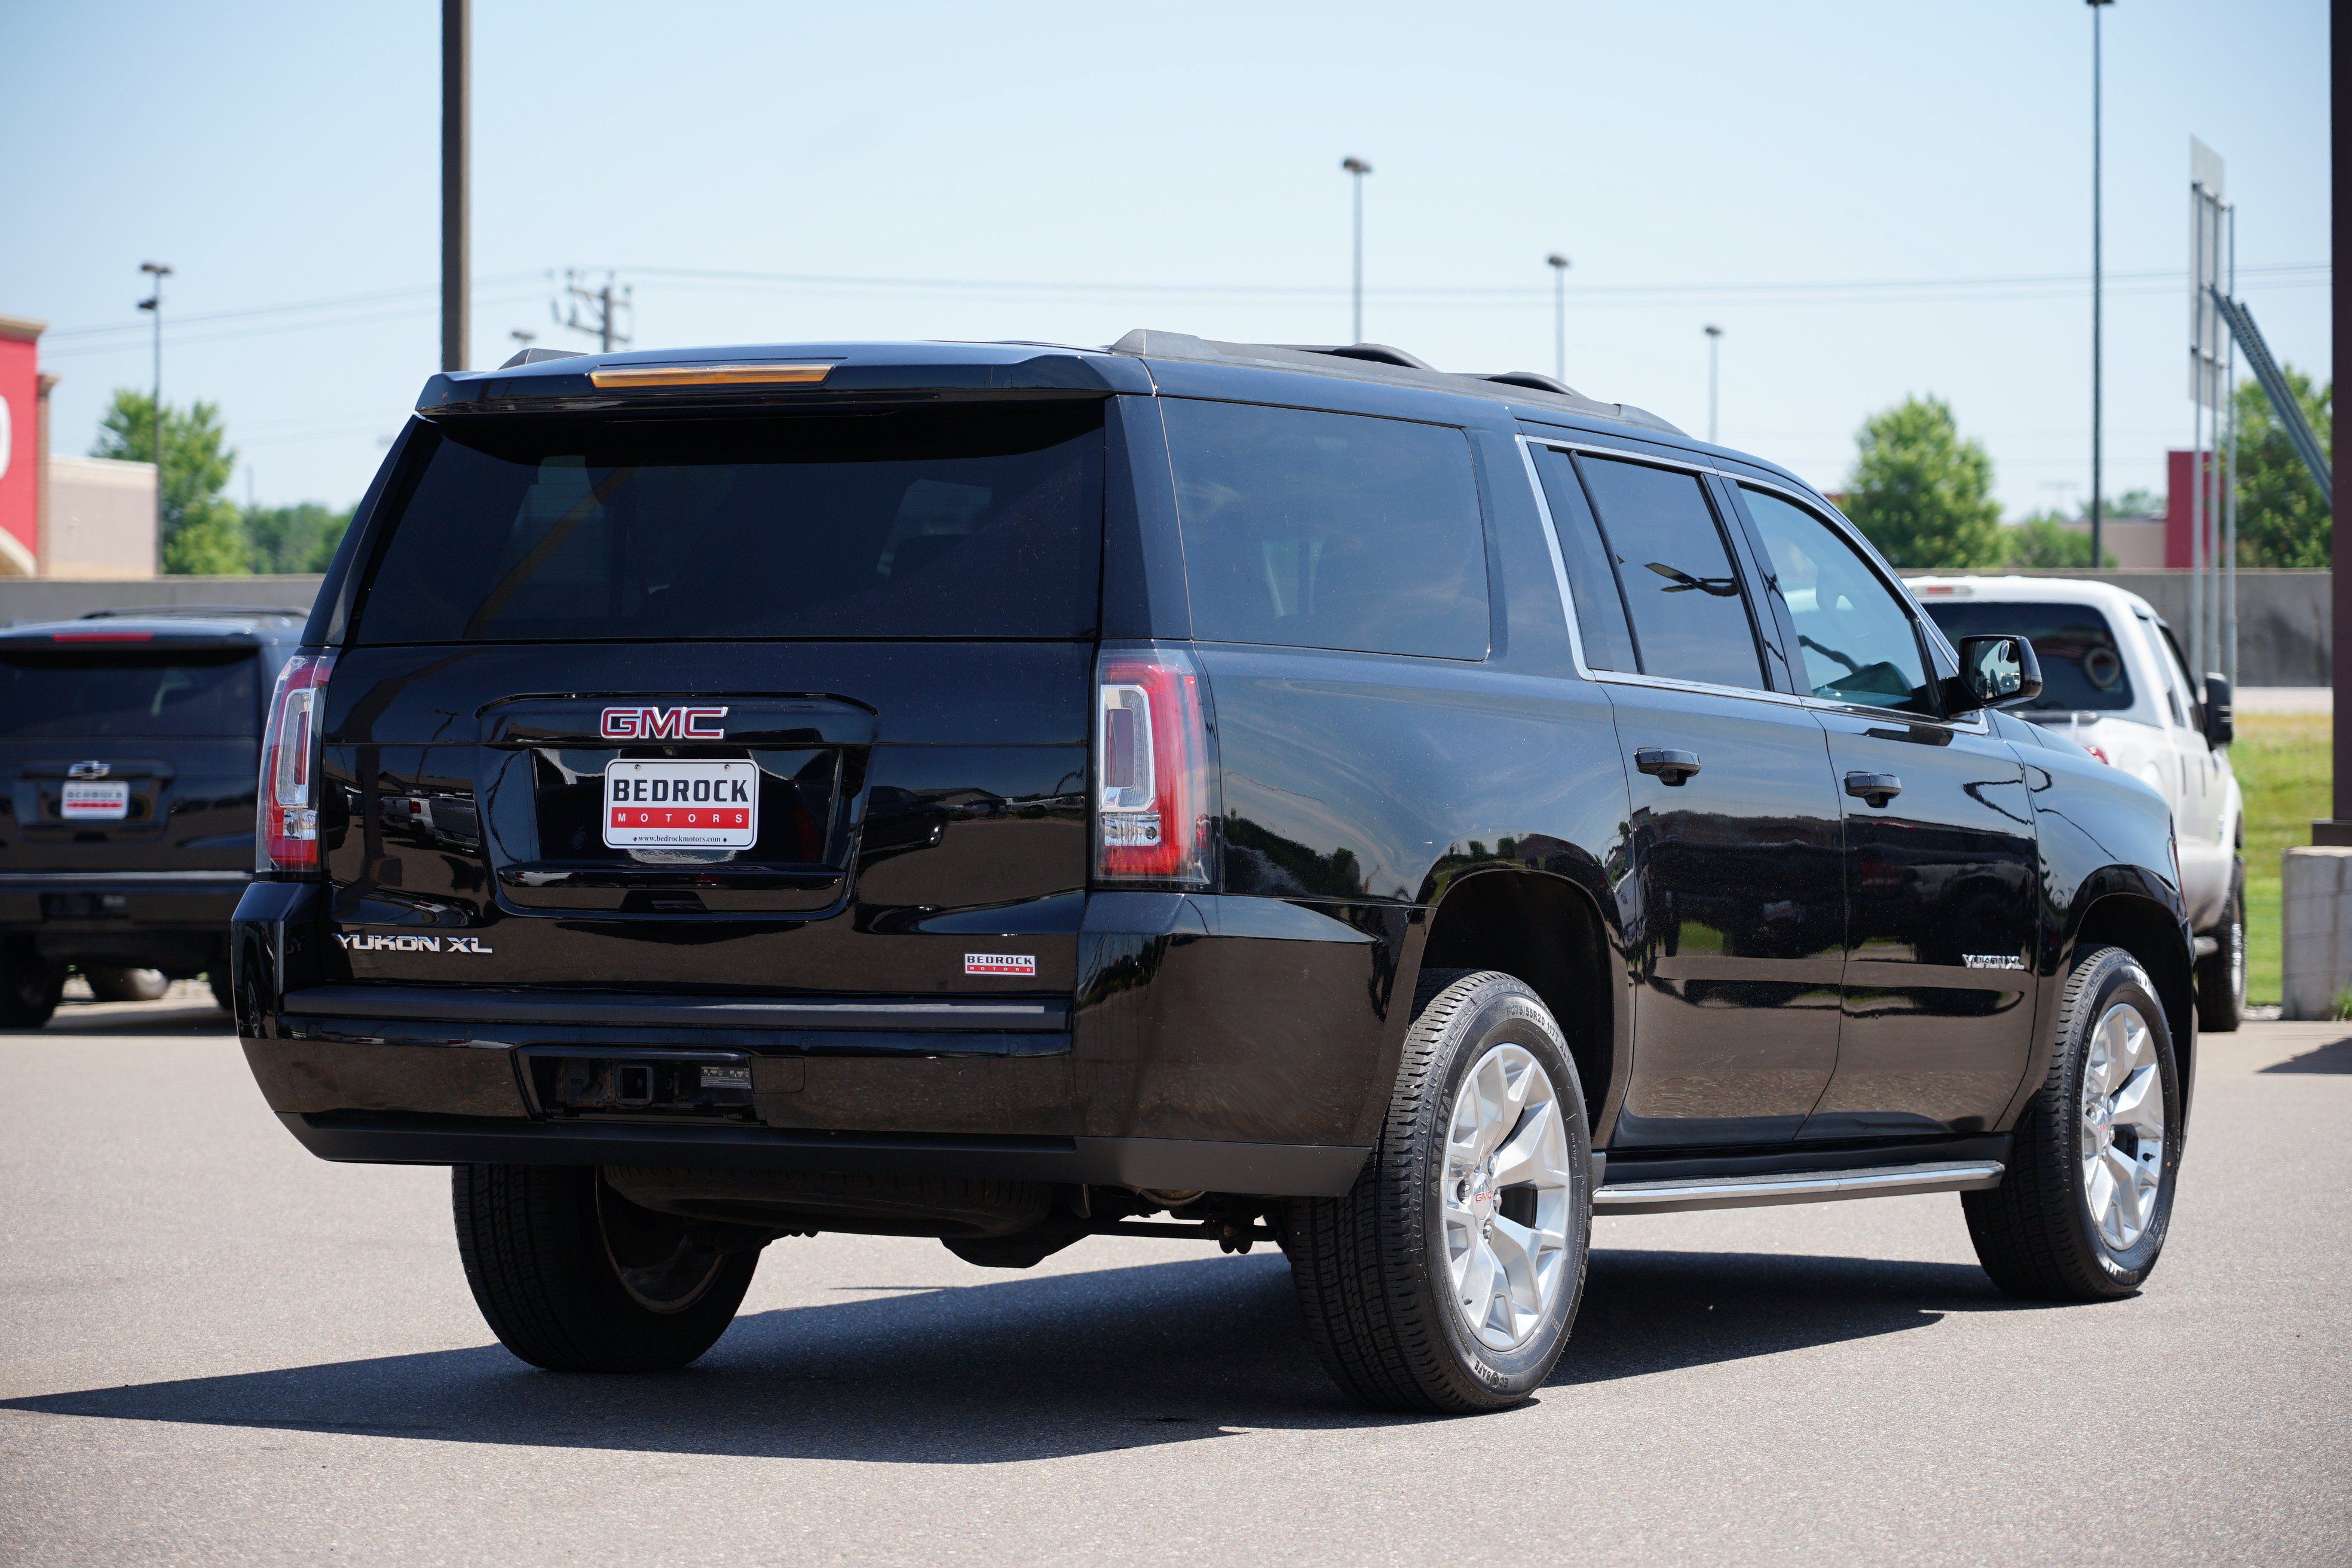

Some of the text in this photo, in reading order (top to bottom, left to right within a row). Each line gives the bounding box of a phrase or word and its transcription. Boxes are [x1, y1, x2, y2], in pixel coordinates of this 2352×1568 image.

[601, 706, 728, 739] GMC
[612, 779, 749, 802] BEDROCK
[617, 813, 743, 823] MOTORS
[638, 835, 721, 843] www.bedrockmotors.com
[331, 933, 494, 954] YUKON XL
[967, 956, 1033, 965] BEDROCK
[1962, 954, 2005, 969] YUKON
[1474, 1190, 1493, 1202] GMC
